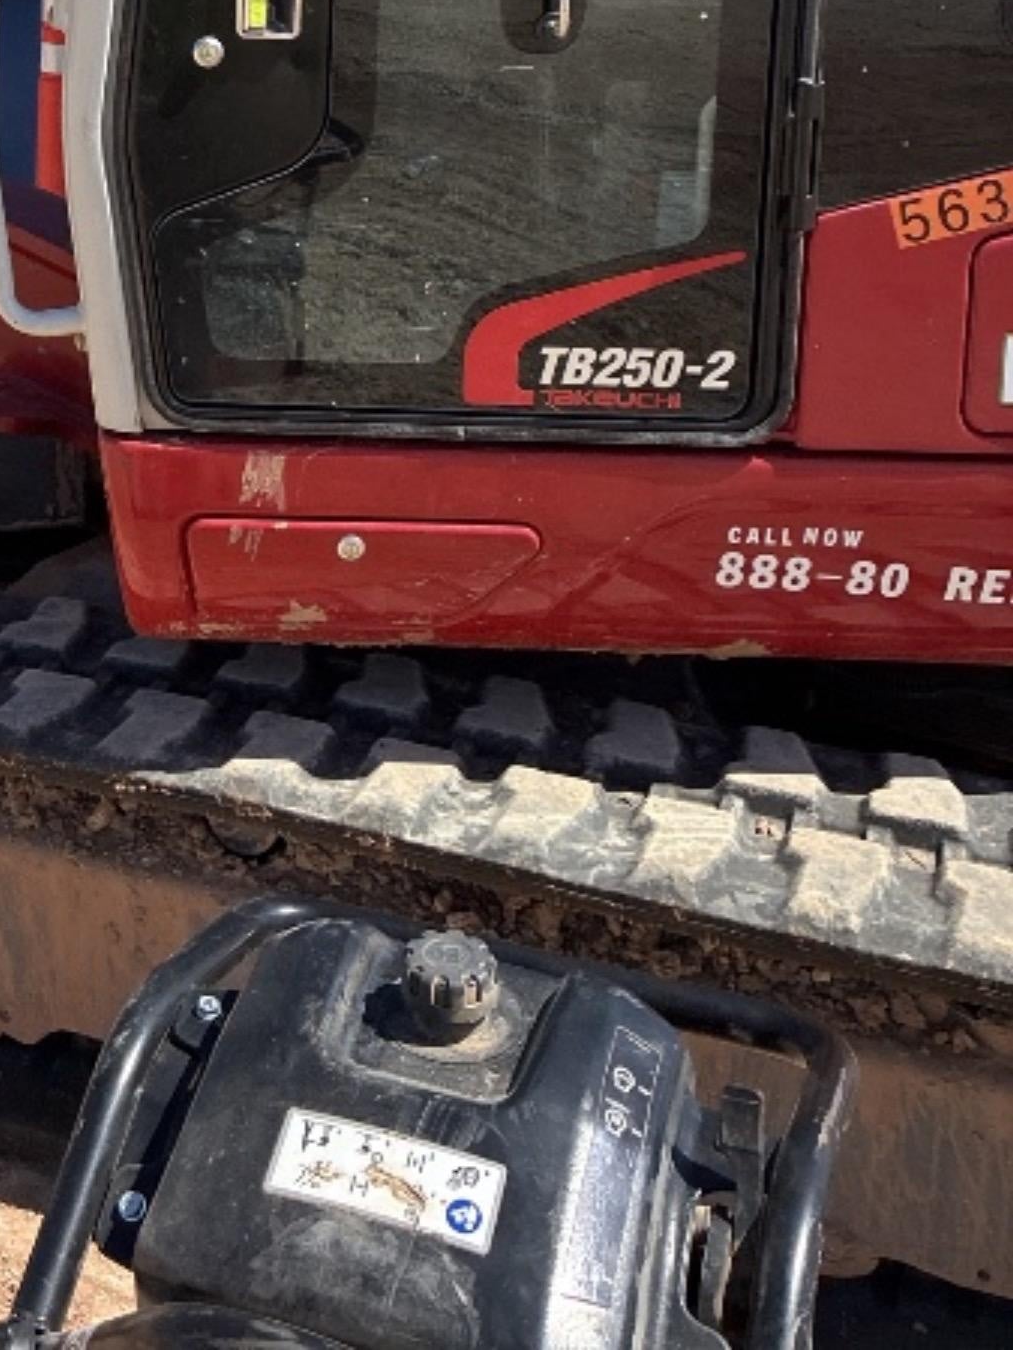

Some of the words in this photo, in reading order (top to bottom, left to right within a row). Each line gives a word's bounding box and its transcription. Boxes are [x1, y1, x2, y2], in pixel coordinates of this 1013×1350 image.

[899, 179, 1008, 242] 563
[539, 347, 737, 390] TB250-2
[727, 526, 793, 547] CALL
[802, 526, 864, 549] NOW
[715, 551, 910, 599] 888-80
[943, 566, 1013, 605] RE
